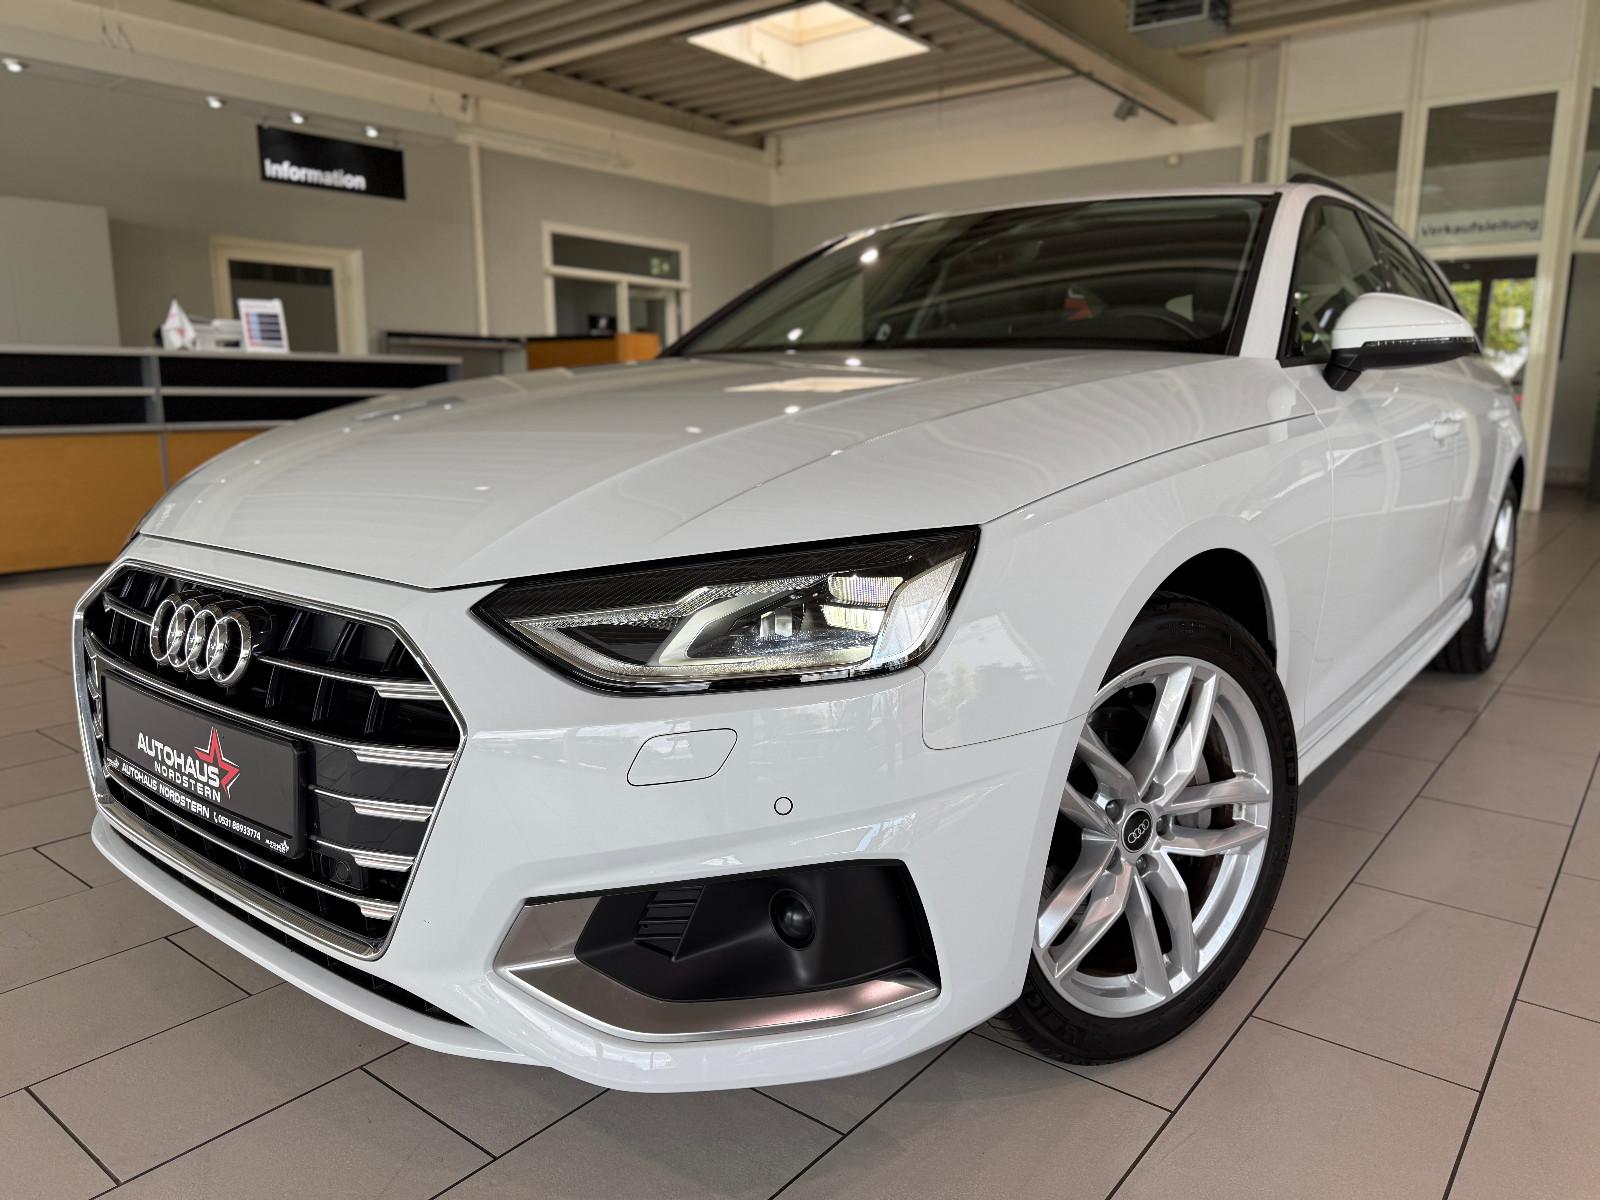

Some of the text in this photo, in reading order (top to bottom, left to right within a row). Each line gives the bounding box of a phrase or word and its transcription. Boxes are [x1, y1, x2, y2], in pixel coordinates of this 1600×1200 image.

[264, 158, 366, 190] Information
[1421, 218, 1539, 237] Verkaufsleitung
[138, 732, 220, 787] AUTOHAUS
[121, 763, 158, 791] AUTOHAUS
[159, 784, 210, 818] NORDSTERN
[218, 814, 232, 828] 0531
[154, 761, 221, 803] NORDSTERN
